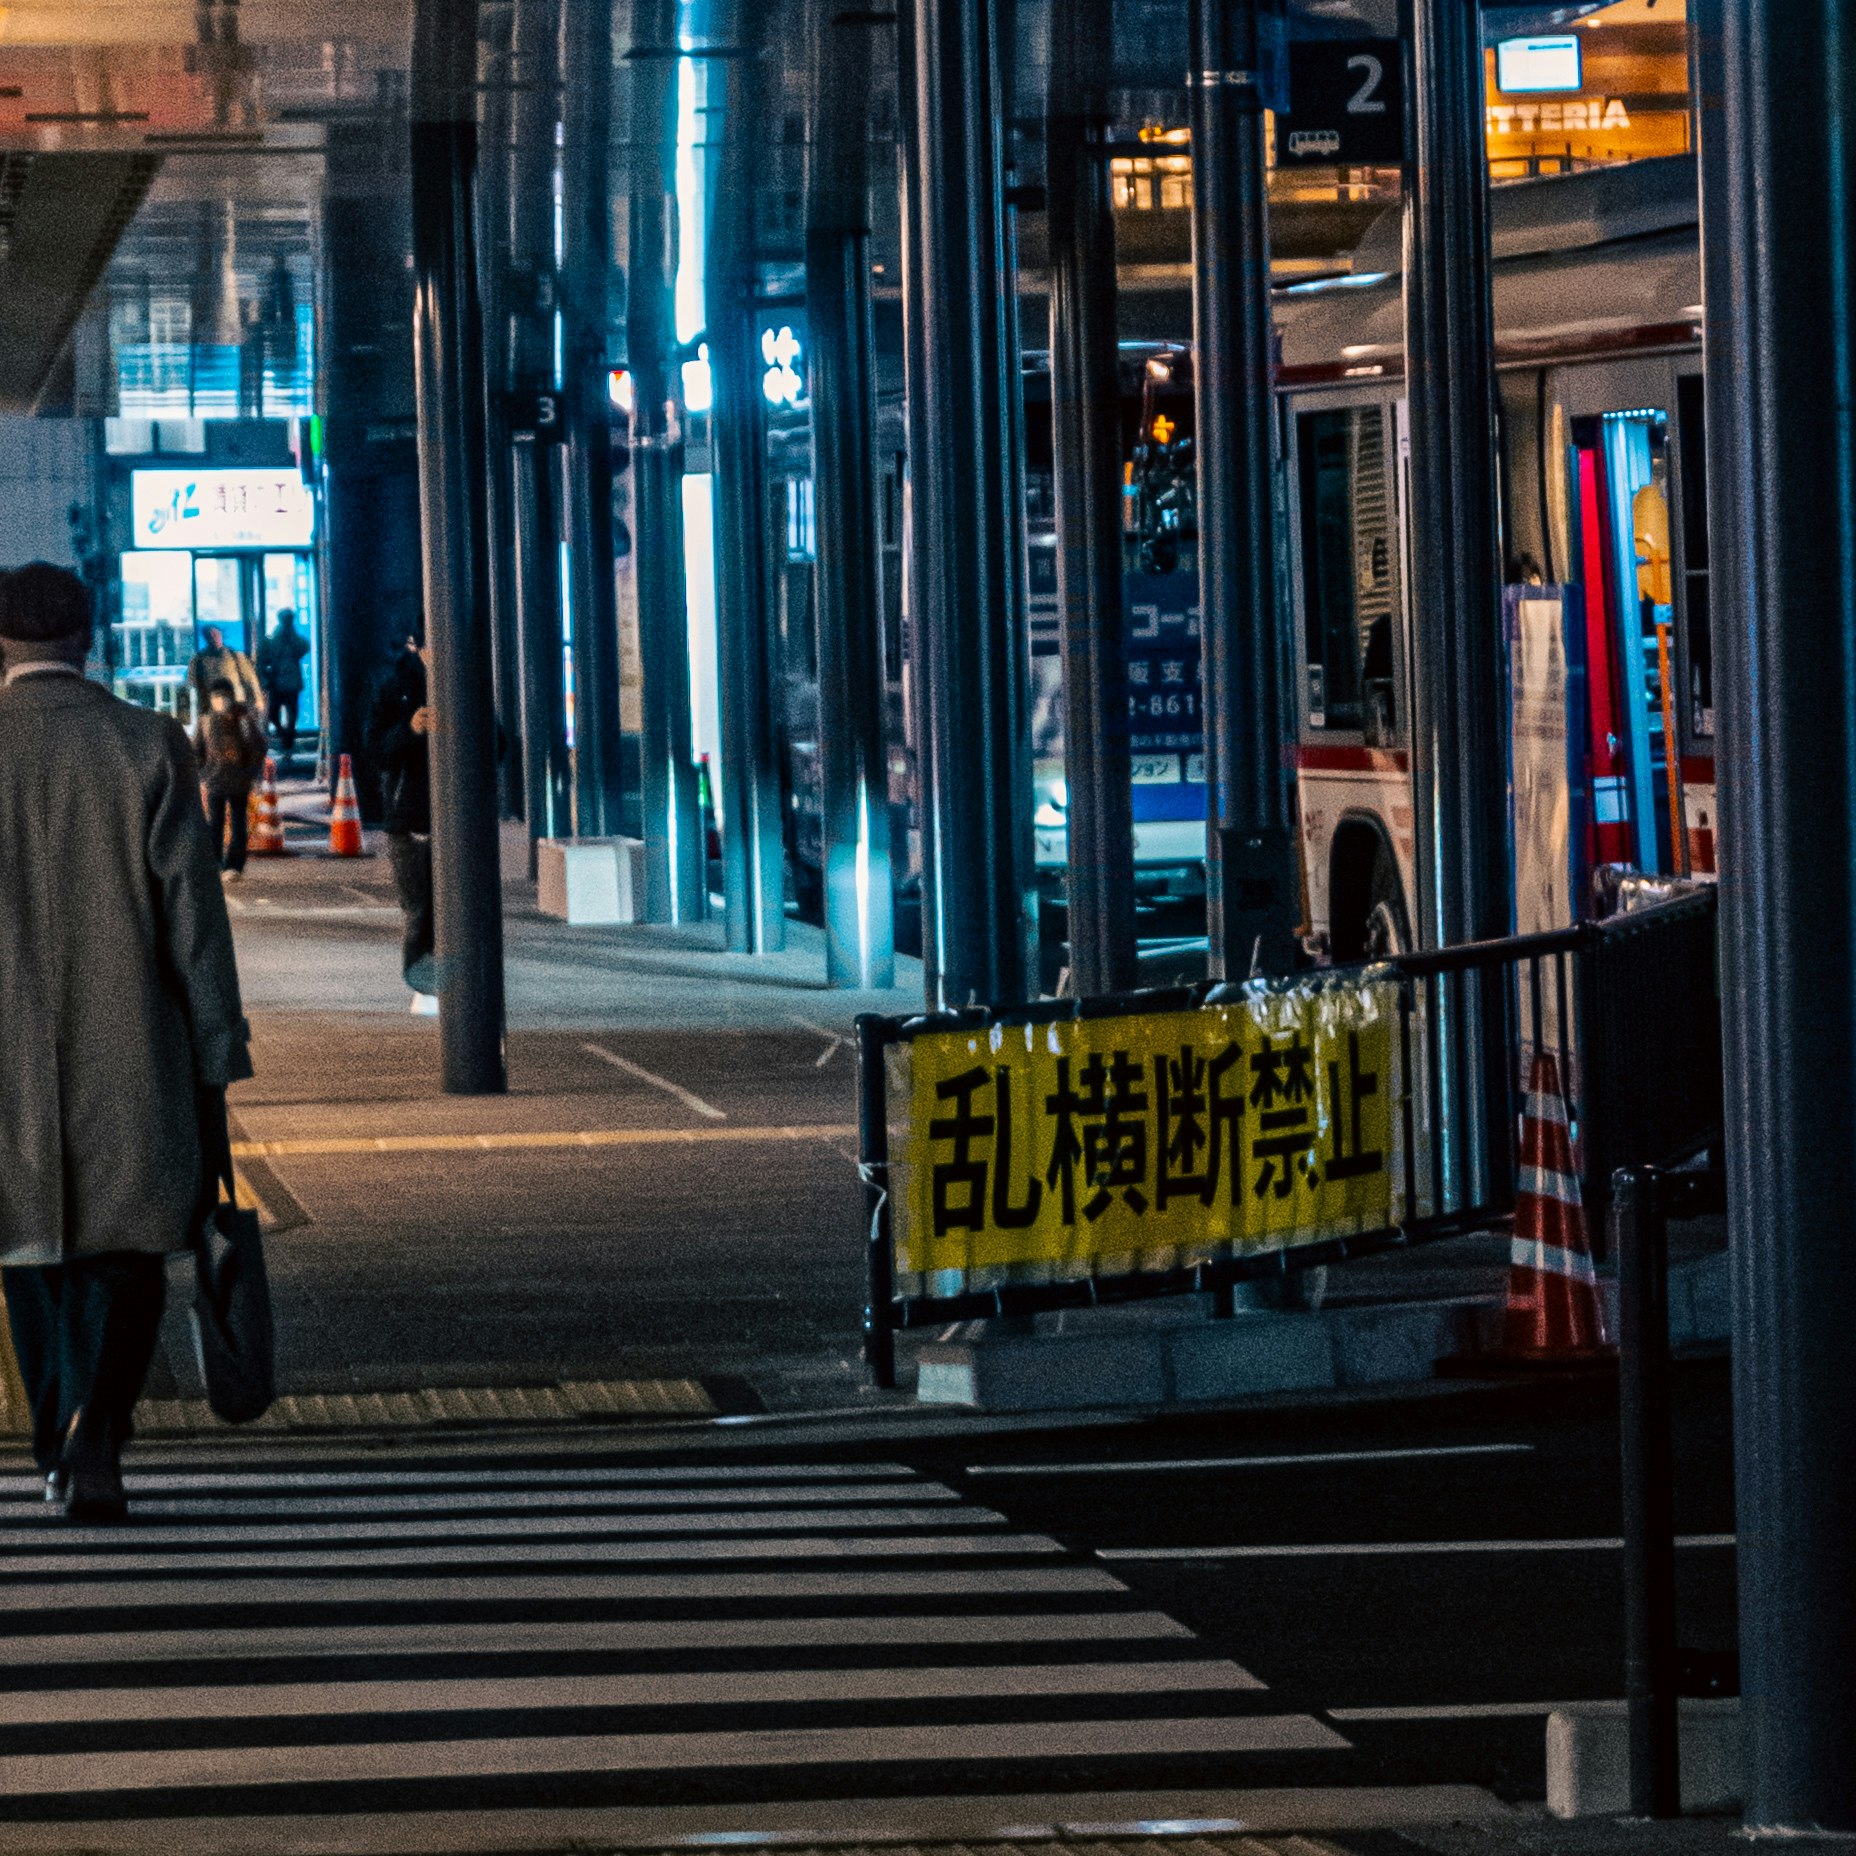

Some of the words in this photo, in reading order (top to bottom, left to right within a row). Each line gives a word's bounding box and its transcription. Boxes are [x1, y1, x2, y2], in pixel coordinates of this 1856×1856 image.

[1347, 54, 1386, 114] 2
[538, 396, 556, 424] 3
[929, 1028, 1383, 1237] 乱横断禁止
